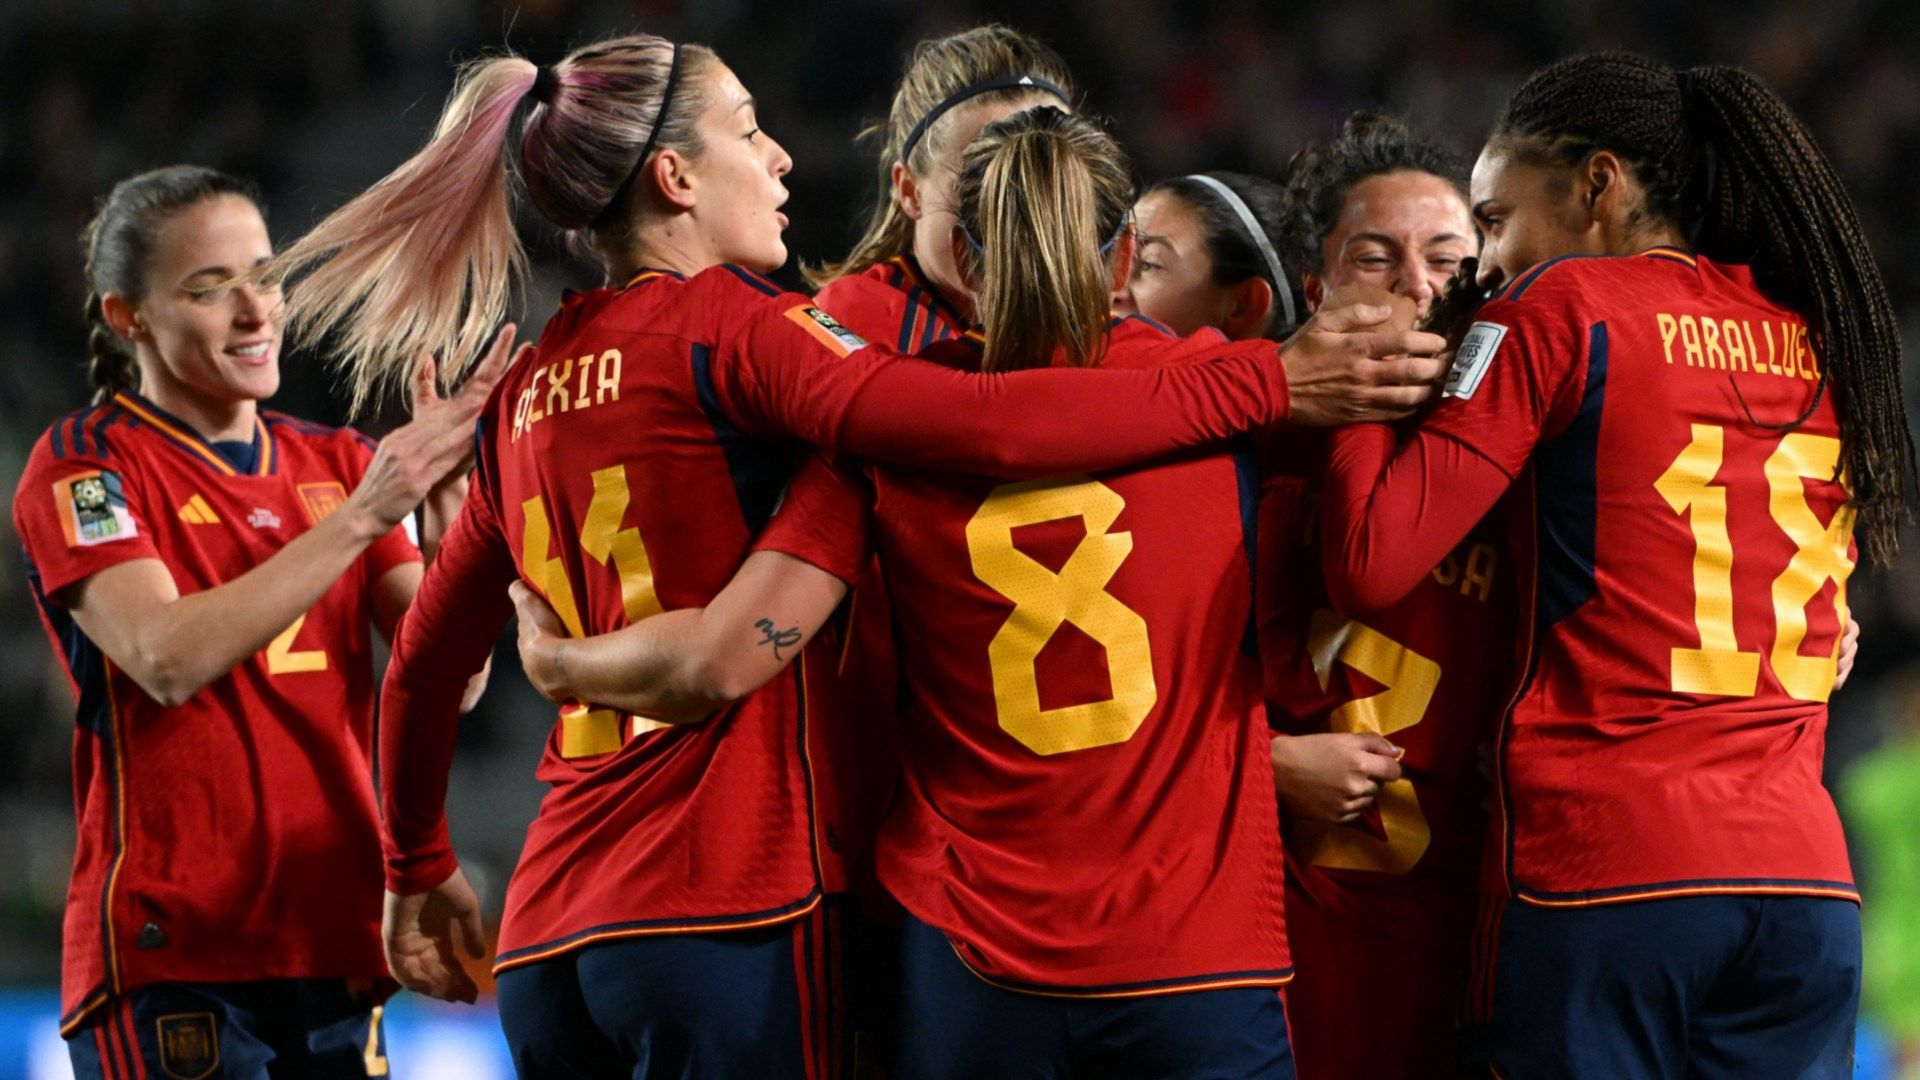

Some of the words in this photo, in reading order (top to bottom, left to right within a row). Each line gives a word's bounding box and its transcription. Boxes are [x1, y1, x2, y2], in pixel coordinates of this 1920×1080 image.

[511, 348, 622, 444] ALEXIA
[1656, 313, 1828, 381] PARALLUEL
[522, 464, 665, 758] 11
[965, 474, 1157, 756] 8
[1653, 423, 1857, 703] 18
